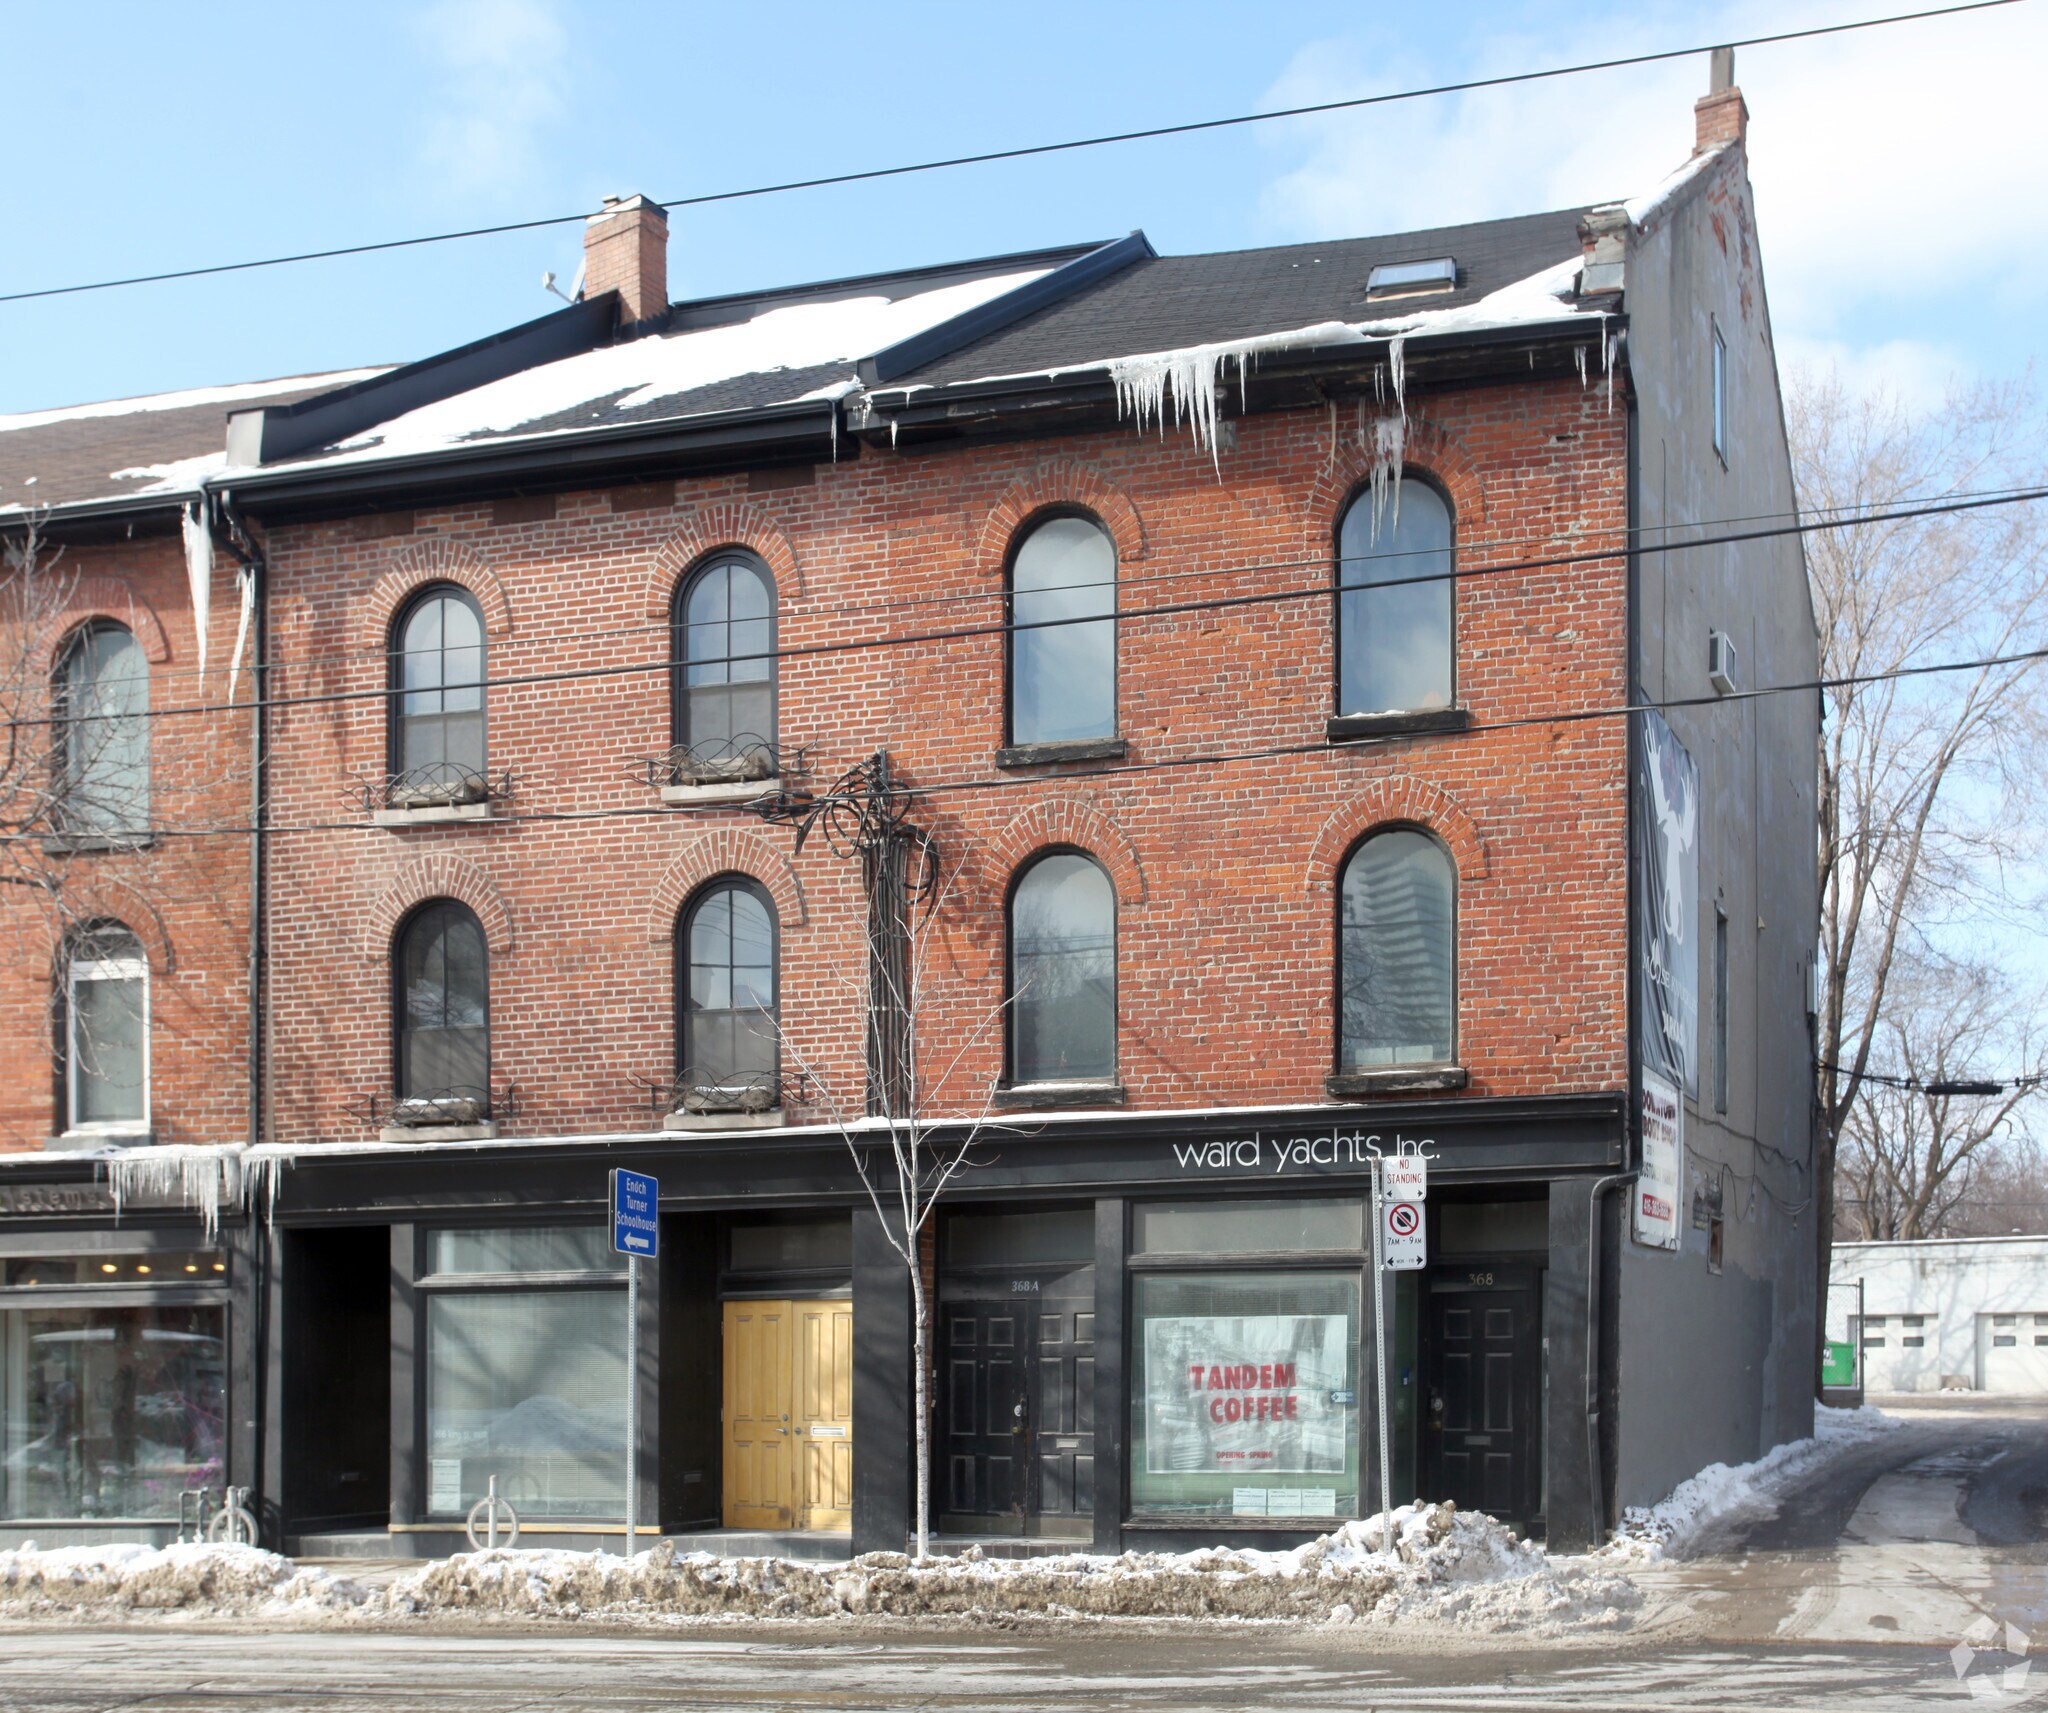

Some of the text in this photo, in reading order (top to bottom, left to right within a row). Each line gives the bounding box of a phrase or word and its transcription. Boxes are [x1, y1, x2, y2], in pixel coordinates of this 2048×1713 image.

[1173, 1132, 1260, 1168] ward
[1272, 1128, 1381, 1172] yachts
[1399, 1159, 1409, 1169] NO
[626, 1177, 647, 1195] Enoch
[1387, 1173, 1422, 1185] STANDING
[626, 1195, 648, 1212] Turner
[616, 1210, 656, 1232] Schoolhouse
[1387, 1237, 1400, 1246] 7AM
[1468, 1272, 1493, 1286] 368
[1189, 1363, 1297, 1390] TANDEM
[1209, 1396, 1297, 1424] COFFEE
[1216, 1451, 1273, 1459] OPENING SPRING
